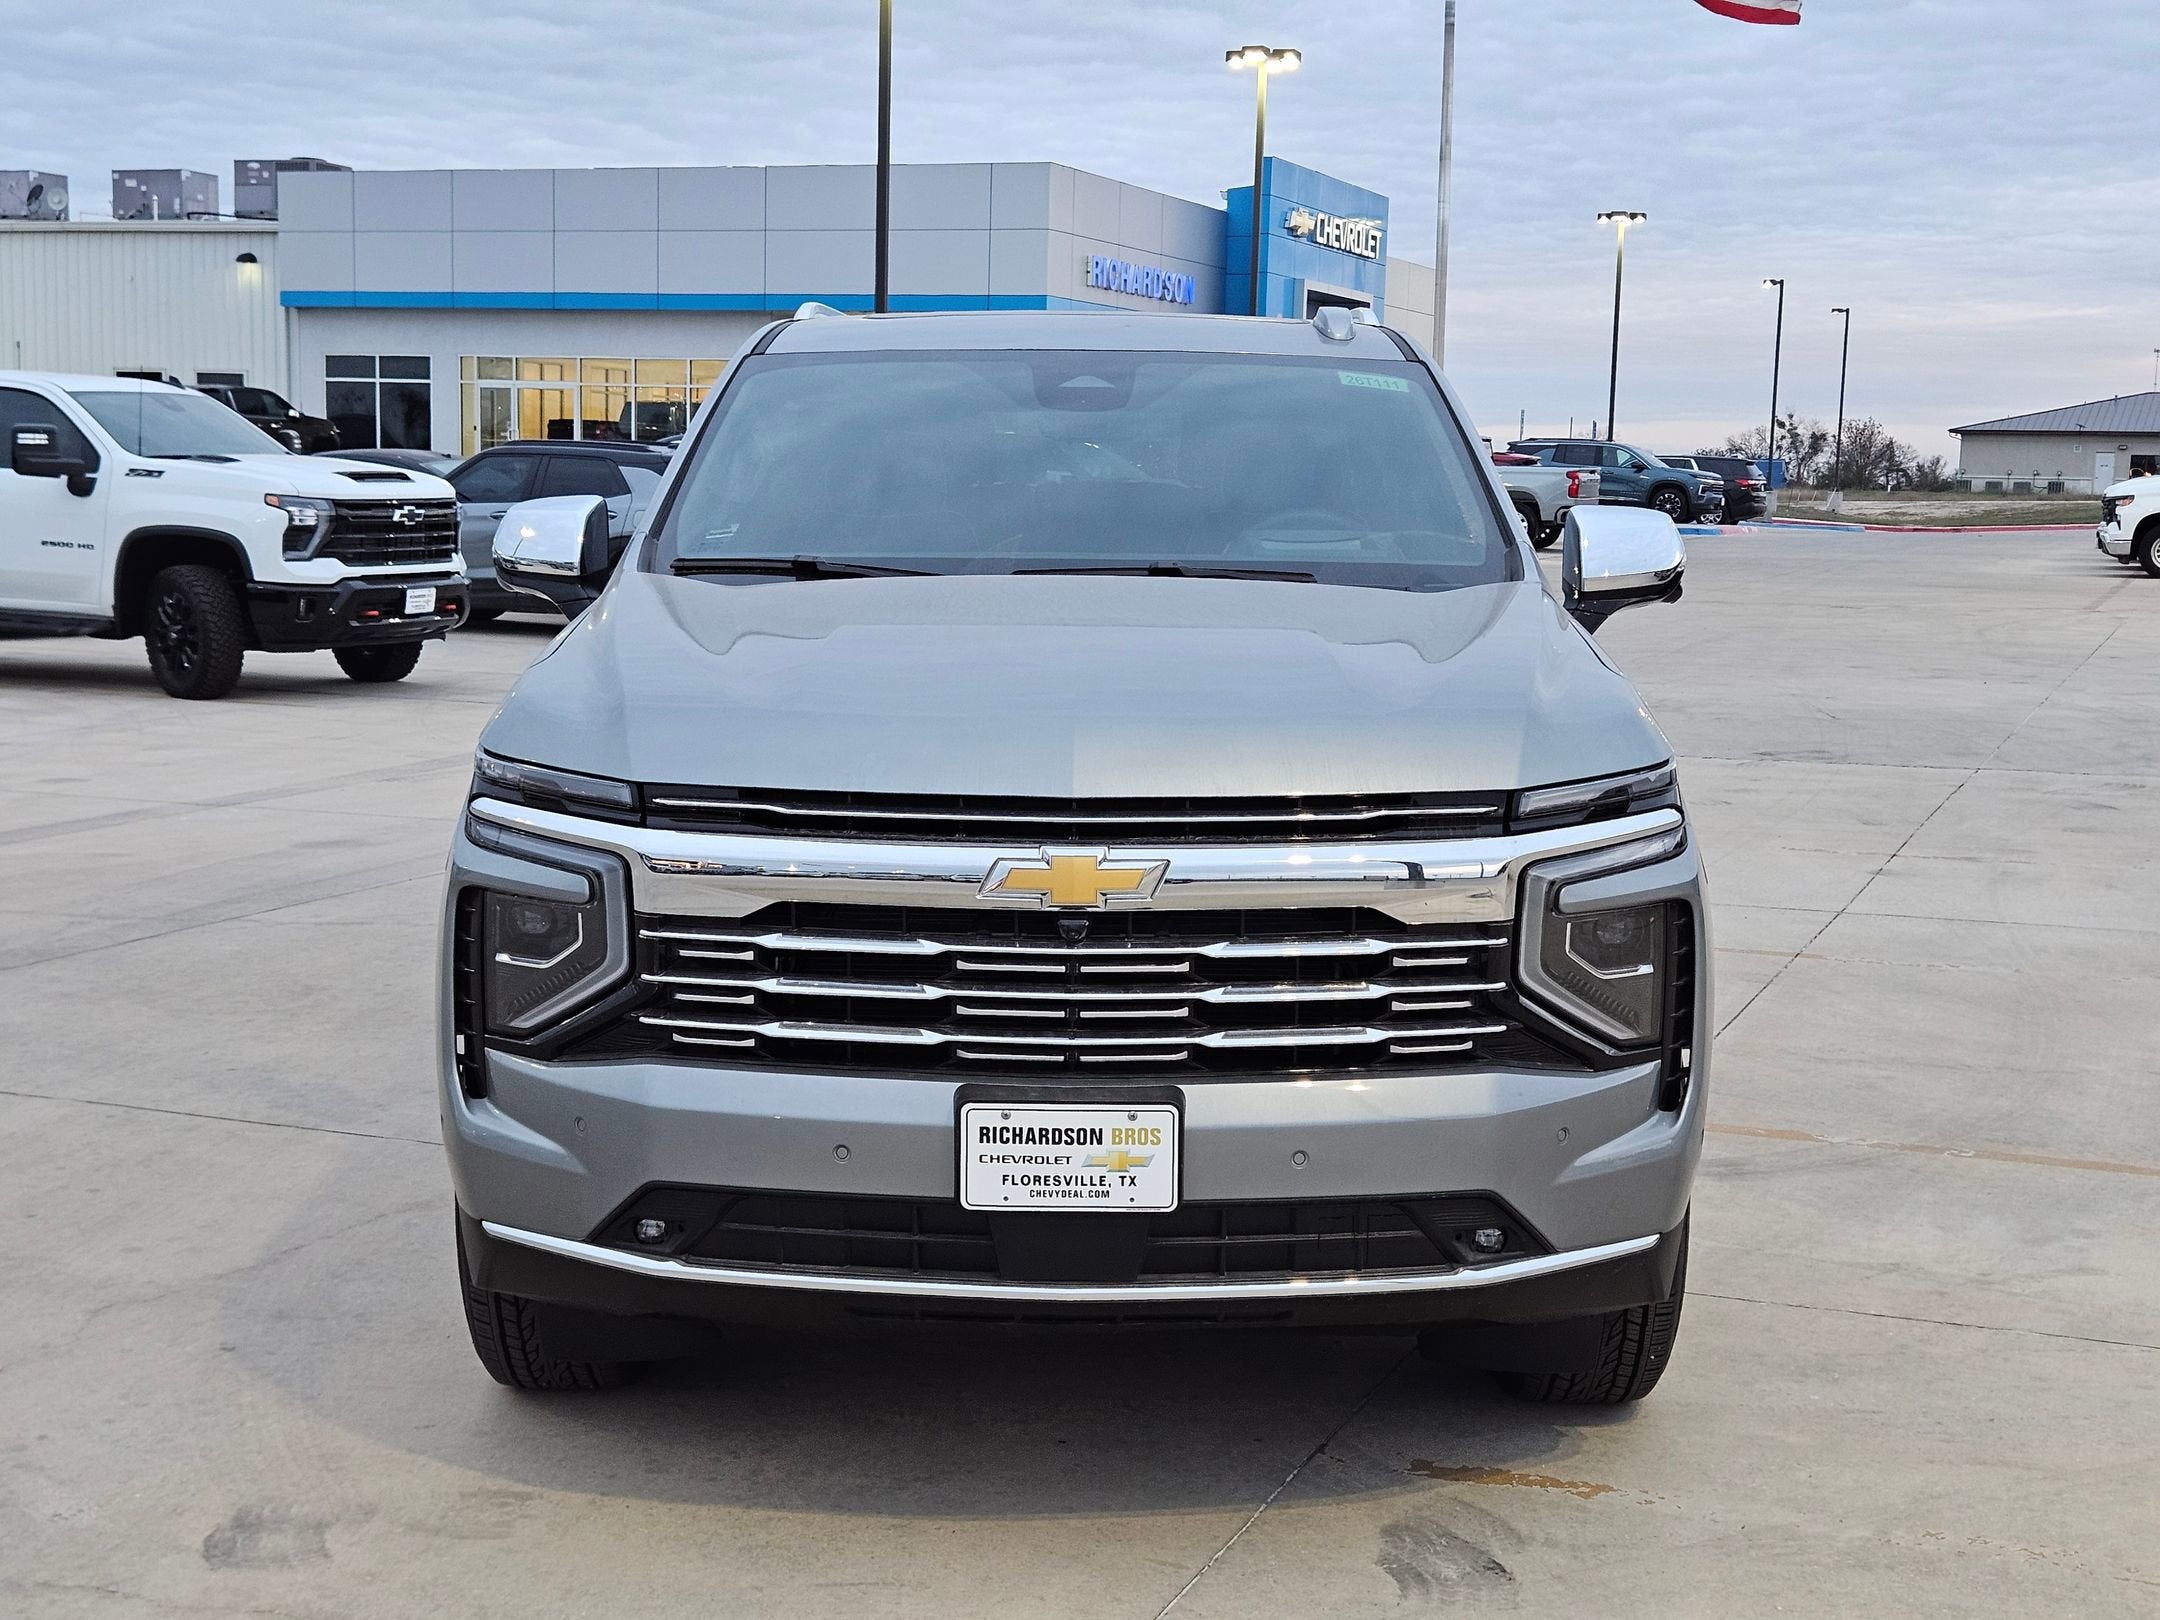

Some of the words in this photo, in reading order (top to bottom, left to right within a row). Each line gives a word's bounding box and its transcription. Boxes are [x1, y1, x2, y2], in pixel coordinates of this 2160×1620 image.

[1316, 212, 1382, 259] CHEVROLET
[1090, 255, 1195, 304] RICHARDSON
[77, 543, 95, 551] HD
[979, 1126, 1103, 1146] RICHARDSON
[1111, 1127, 1161, 1146] BROS
[979, 1154, 1073, 1165] CHEVROLET
[1002, 1174, 1112, 1188] FLORESVILLE,
[1119, 1175, 1137, 1187] TX
[1029, 1189, 1110, 1199] CHEVYDEAL.COM
